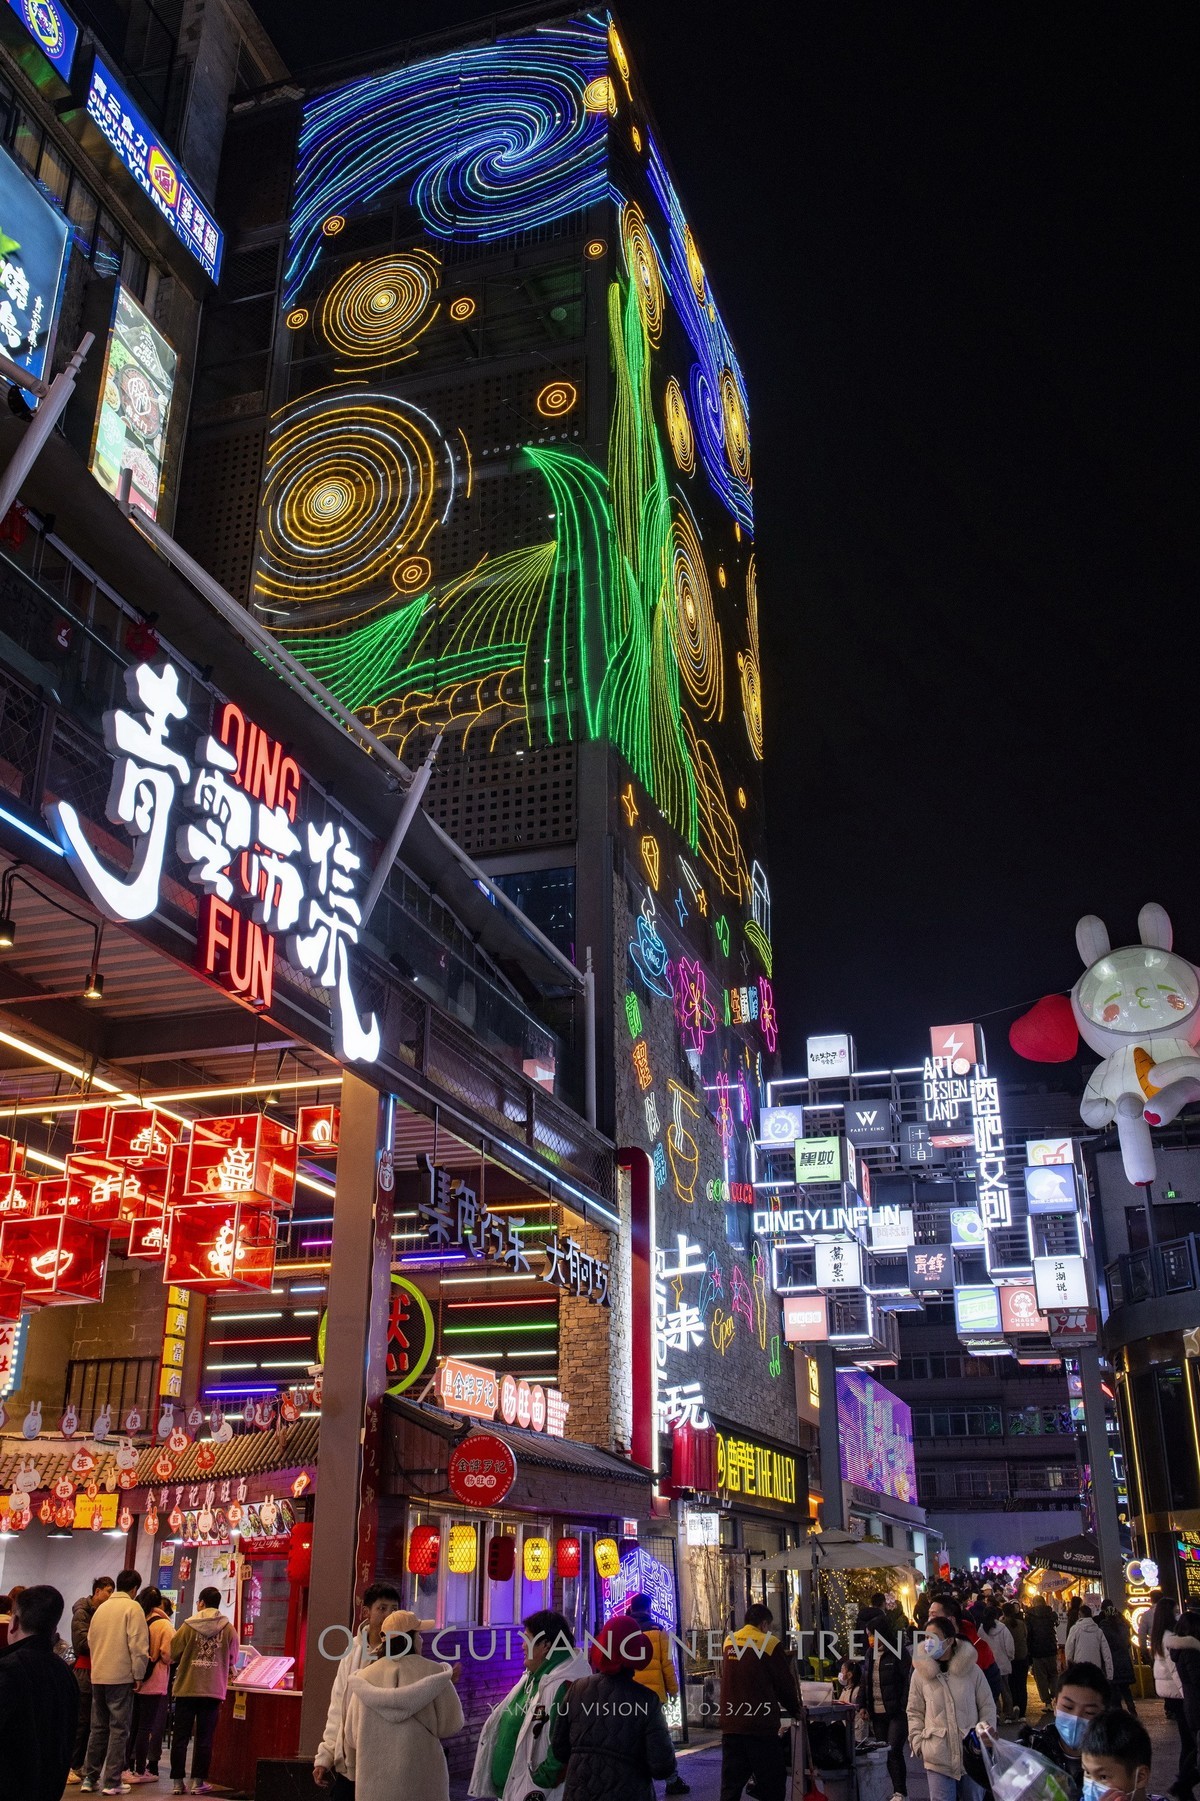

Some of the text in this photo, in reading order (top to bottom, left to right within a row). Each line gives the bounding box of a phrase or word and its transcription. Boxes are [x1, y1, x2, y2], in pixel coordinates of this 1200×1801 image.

[89, 90, 146, 170] QINGYUNFUN
[221, 703, 301, 822] QING
[206, 899, 275, 1010] FUN
[924, 1056, 953, 1080] ART
[924, 1079, 967, 1101] DESIGN
[774, 1122, 789, 1134] 24
[925, 1100, 959, 1122] LAND
[753, 1205, 901, 1234] QINGYUNFUN
[659, 1234, 711, 1430] 上来玩
[453, 1370, 495, 1409] 金牌罗记
[503, 1381, 544, 1424] 肠旺面
[456, 1458, 508, 1474] 金牌罗记
[756, 1447, 772, 1498] THE
[773, 1452, 796, 1504] ALLEY
